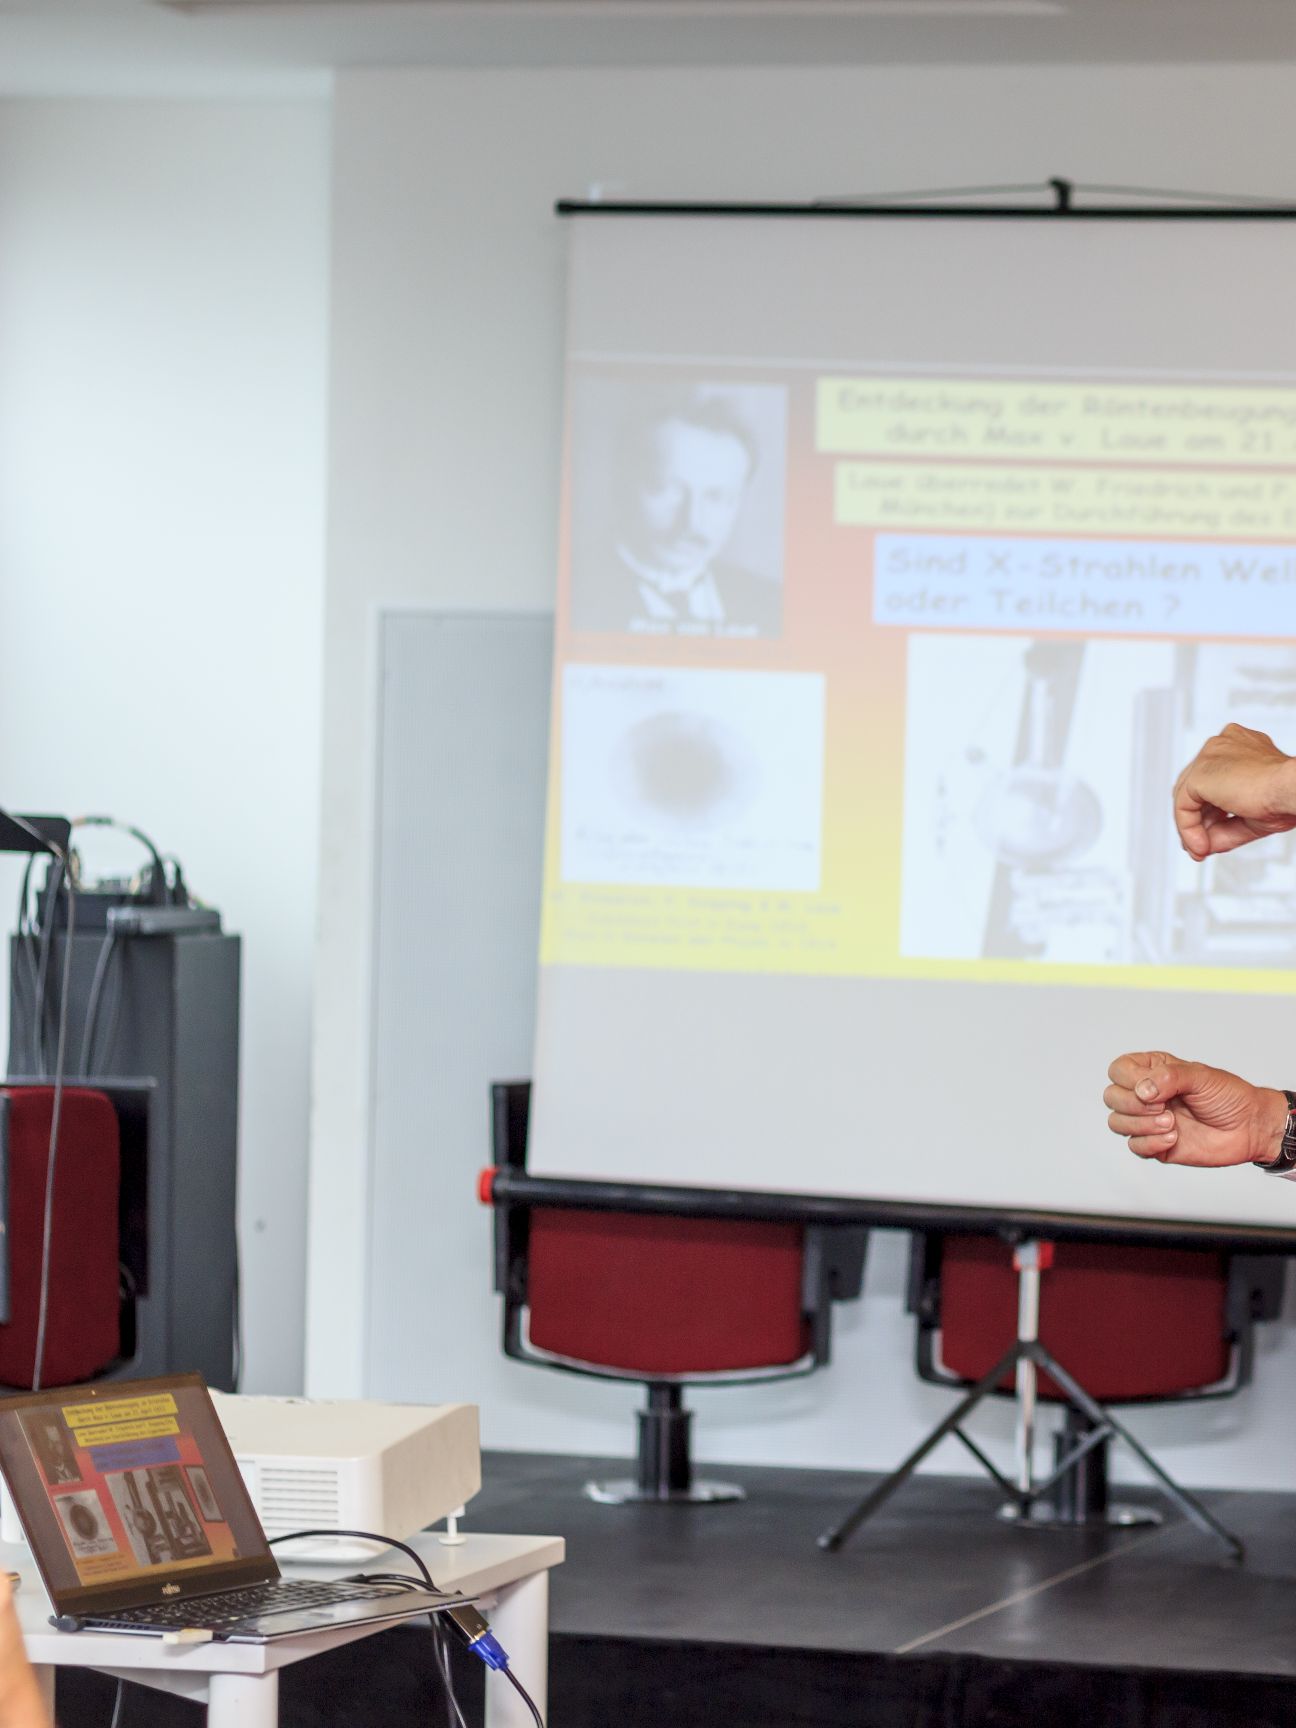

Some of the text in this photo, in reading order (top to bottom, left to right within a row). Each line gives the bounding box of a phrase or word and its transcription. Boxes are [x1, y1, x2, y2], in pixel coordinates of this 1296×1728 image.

[885, 545, 969, 577] Sind
[884, 584, 970, 613] oder
[986, 587, 1145, 620] Teilchen
